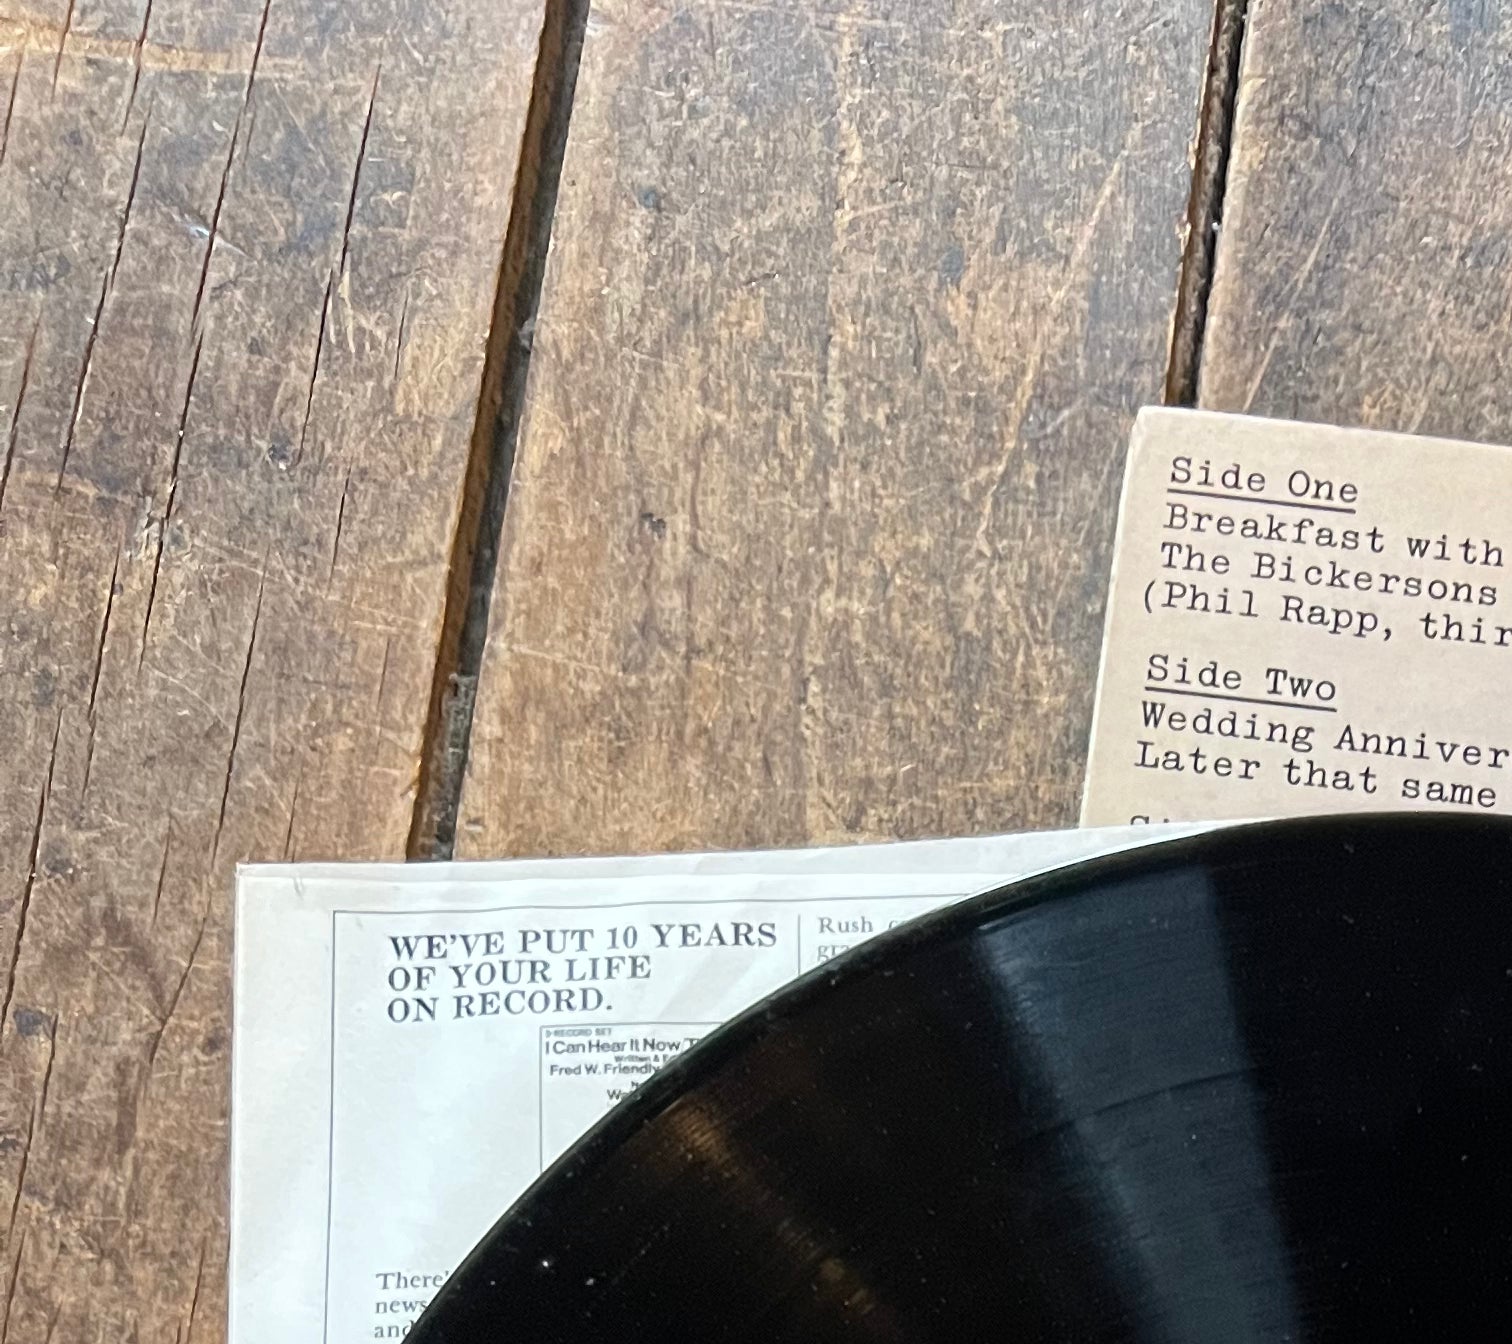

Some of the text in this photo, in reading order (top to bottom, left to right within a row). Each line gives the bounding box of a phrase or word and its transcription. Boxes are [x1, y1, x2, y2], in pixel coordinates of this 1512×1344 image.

[1170, 455, 1359, 504] Side One
[1162, 501, 1385, 554] Breakfast
[1406, 533, 1505, 568] with
[1160, 540, 1231, 576] The
[1249, 551, 1498, 607] Bickersons
[1143, 578, 1260, 619] (Phil
[1278, 594, 1393, 643] Rapp,
[1146, 652, 1337, 702] Side Two
[1141, 699, 1316, 754] Wedding
[1133, 739, 1262, 781] Later
[1282, 757, 1378, 795] that
[1401, 777, 1497, 808] same
[387, 921, 778, 961] WE'VE PUT 10 YEARS
[818, 915, 874, 934] Rush
[387, 954, 652, 992] OF YOUR LIFE
[386, 987, 613, 1024] ON RECORD.
[550, 1064, 582, 1076] Fred
[604, 1063, 662, 1074] Friendly
[553, 1040, 586, 1054] Can
[588, 1040, 627, 1053] Hear
[643, 1037, 680, 1052] Now
